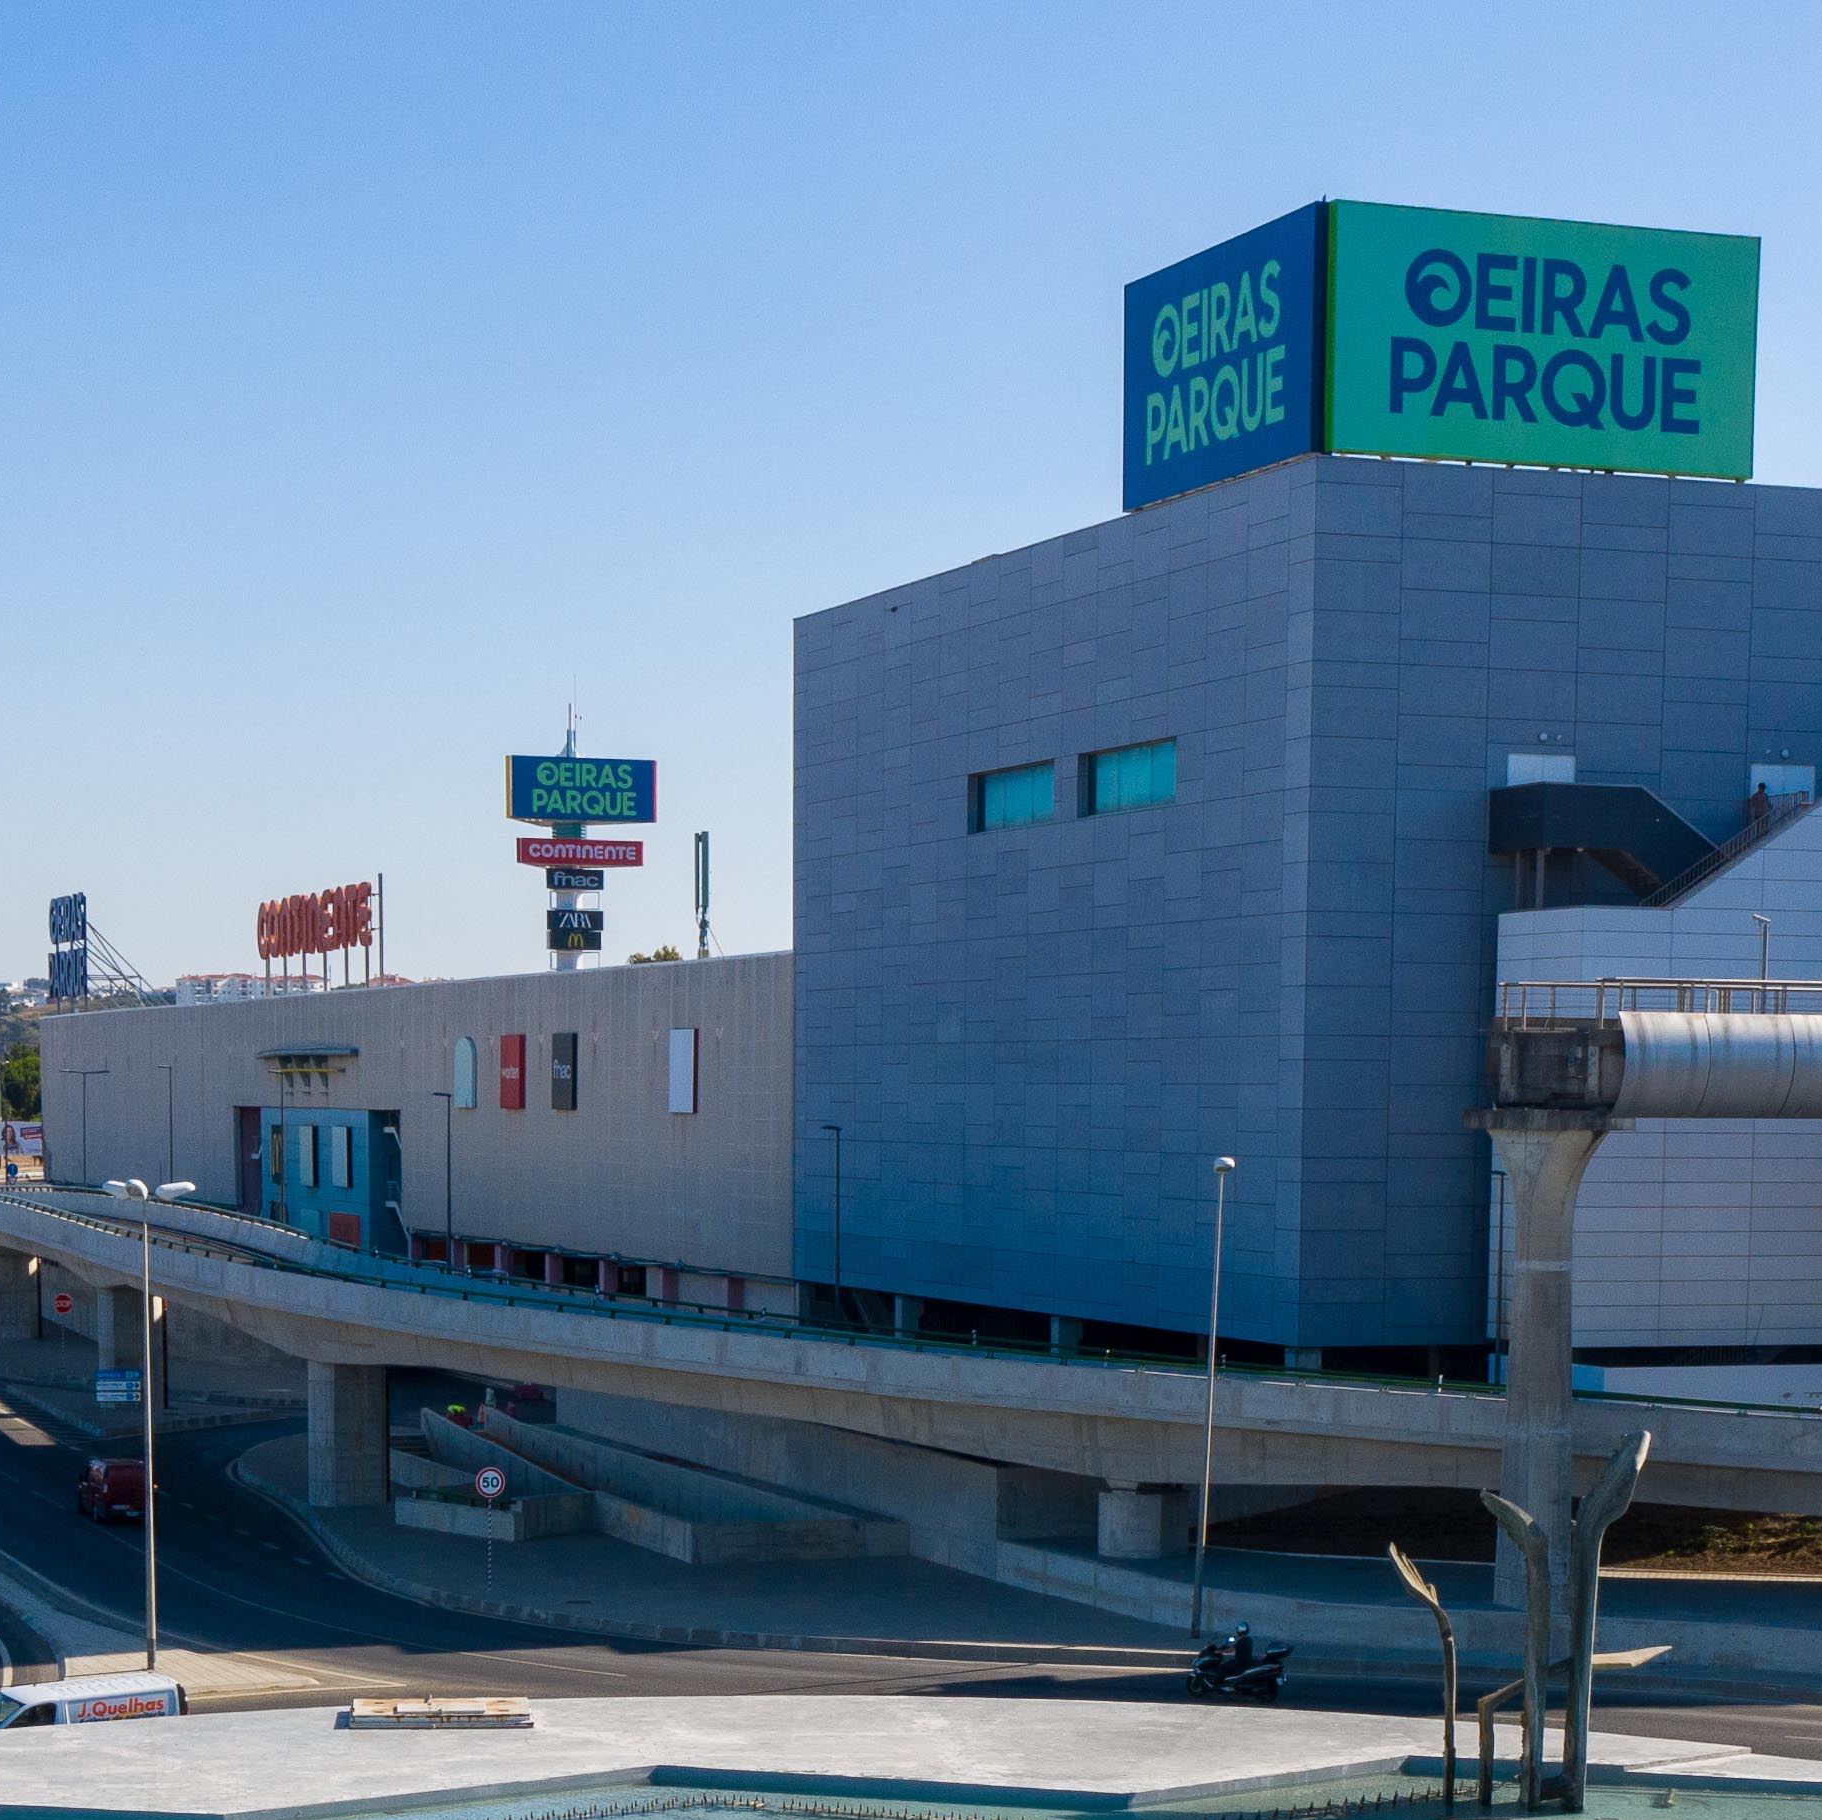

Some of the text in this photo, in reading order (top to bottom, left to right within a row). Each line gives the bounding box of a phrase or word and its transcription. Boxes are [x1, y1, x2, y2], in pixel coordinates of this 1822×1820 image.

[1405, 248, 1692, 346] OEIRAS
[1152, 258, 1280, 378] OEIRAS
[1390, 336, 1701, 435] PARQUE
[1145, 344, 1285, 465] PARQUE
[536, 761, 633, 789] OEIRAS
[532, 788, 637, 817] PARQUE
[528, 843, 636, 861] CONTINENTE
[553, 871, 599, 887] fnac
[559, 912, 591, 928] ZARA
[553, 1059, 571, 1079] fnac
[482, 1476, 500, 1489] 50
